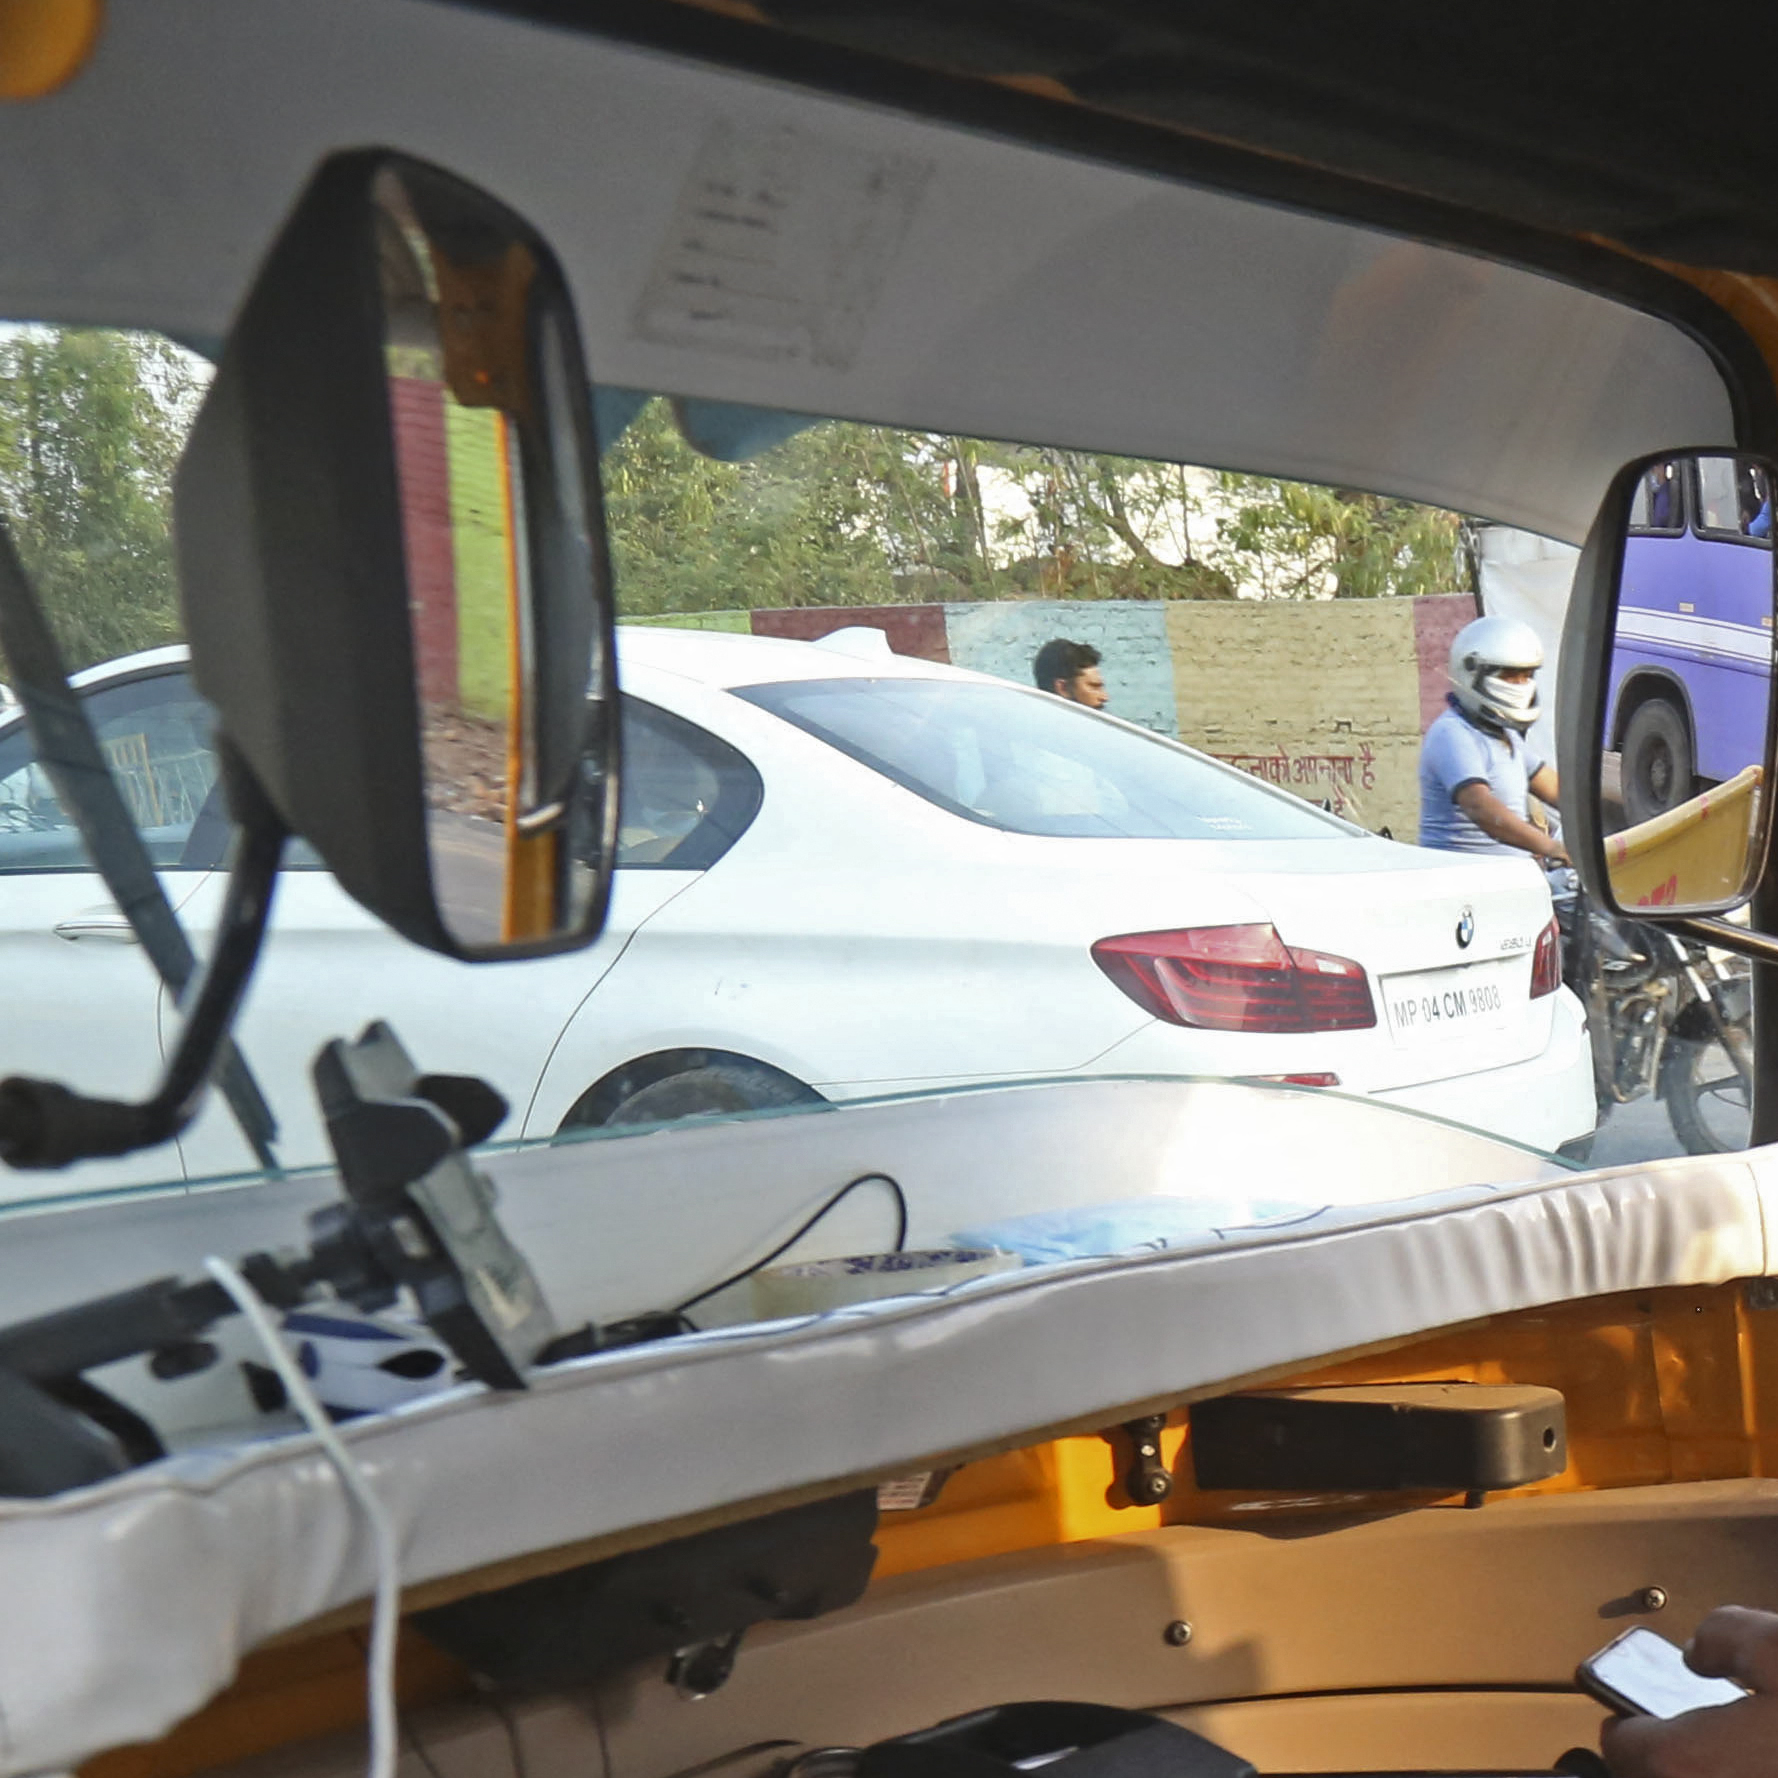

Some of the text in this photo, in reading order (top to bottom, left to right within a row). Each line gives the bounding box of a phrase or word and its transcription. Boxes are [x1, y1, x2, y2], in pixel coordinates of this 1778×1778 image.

[1359, 741, 1376, 790] है
[1393, 985, 1502, 1028] MP 04 CM 9808
